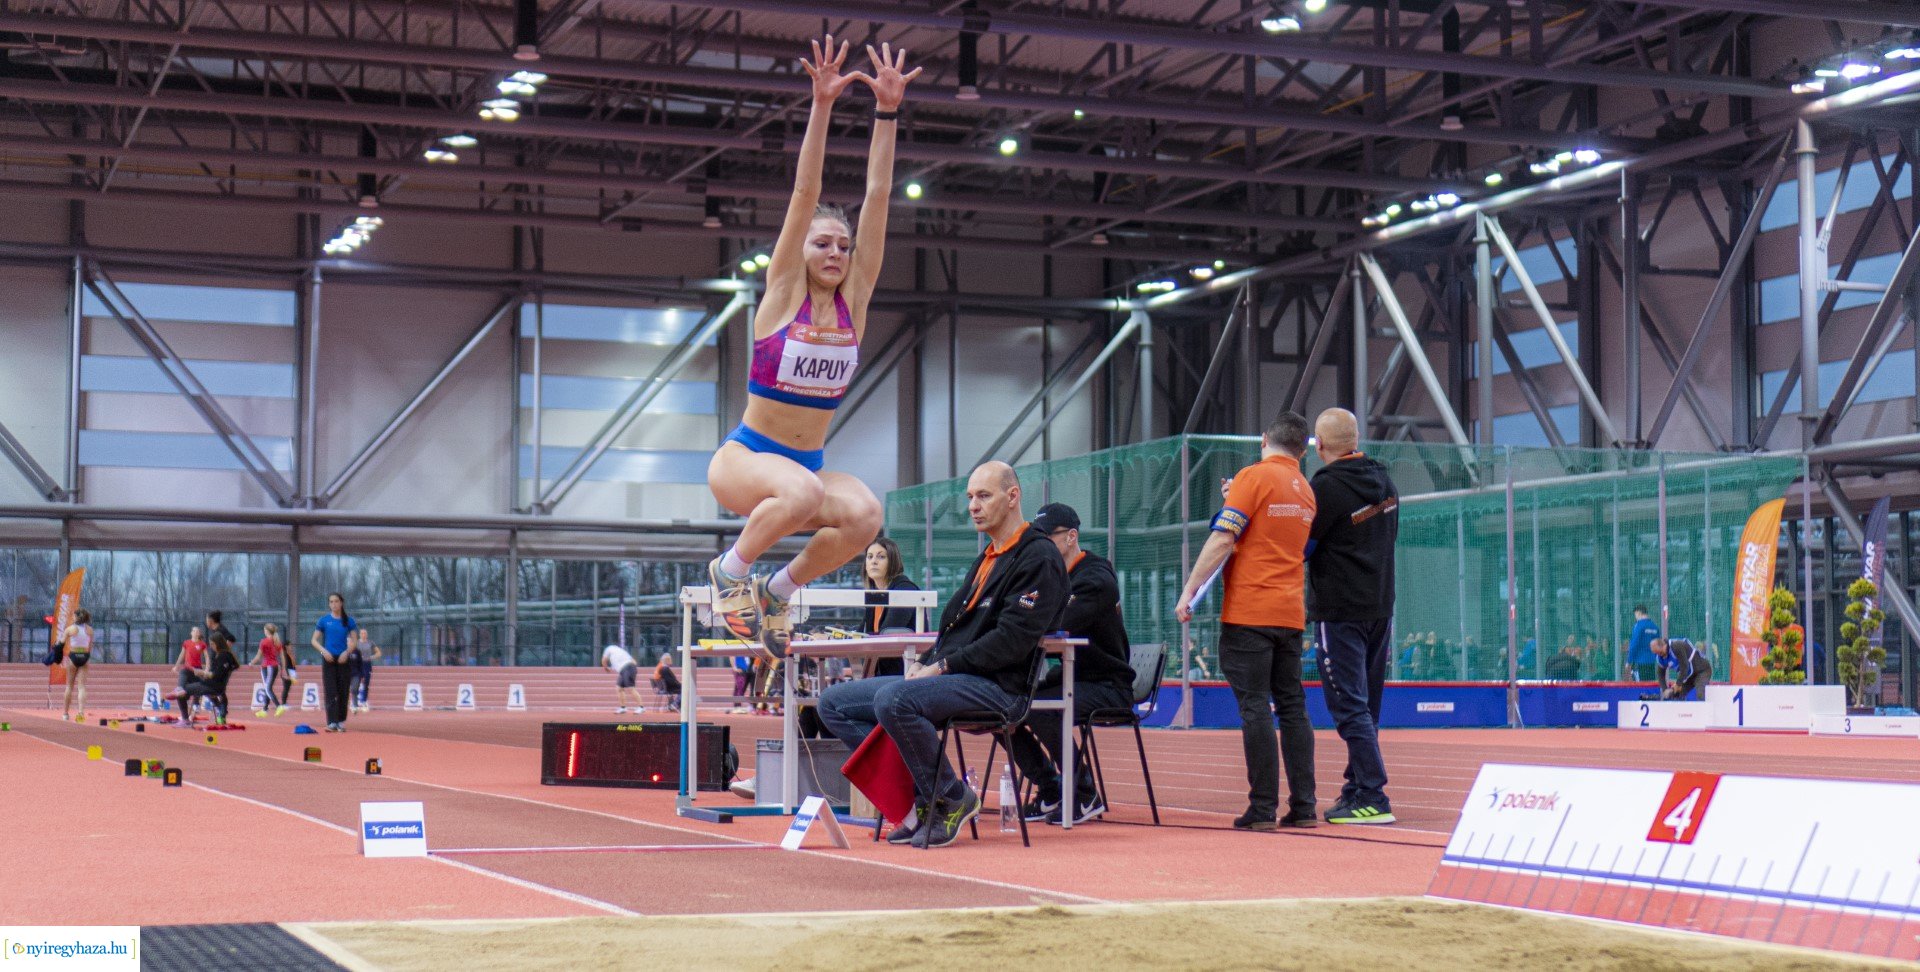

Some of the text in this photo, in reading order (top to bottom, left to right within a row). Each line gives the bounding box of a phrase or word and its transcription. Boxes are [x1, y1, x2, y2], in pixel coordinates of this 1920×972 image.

[793, 356, 850, 380] KAPUY
[1738, 541, 1759, 635] #MAGYAR
[147, 687, 157, 703] 8
[255, 688, 266, 704] 6
[306, 688, 317, 704] 5
[409, 688, 419, 704] 3
[461, 688, 471, 704] 2
[512, 689, 520, 704] 1
[1732, 688, 1744, 726] 1
[1640, 704, 1650, 727] 2
[1844, 718, 1852, 733] 3
[1498, 789, 1560, 812] polanik
[1663, 787, 1702, 842] 4
[382, 825, 419, 836] polanik
